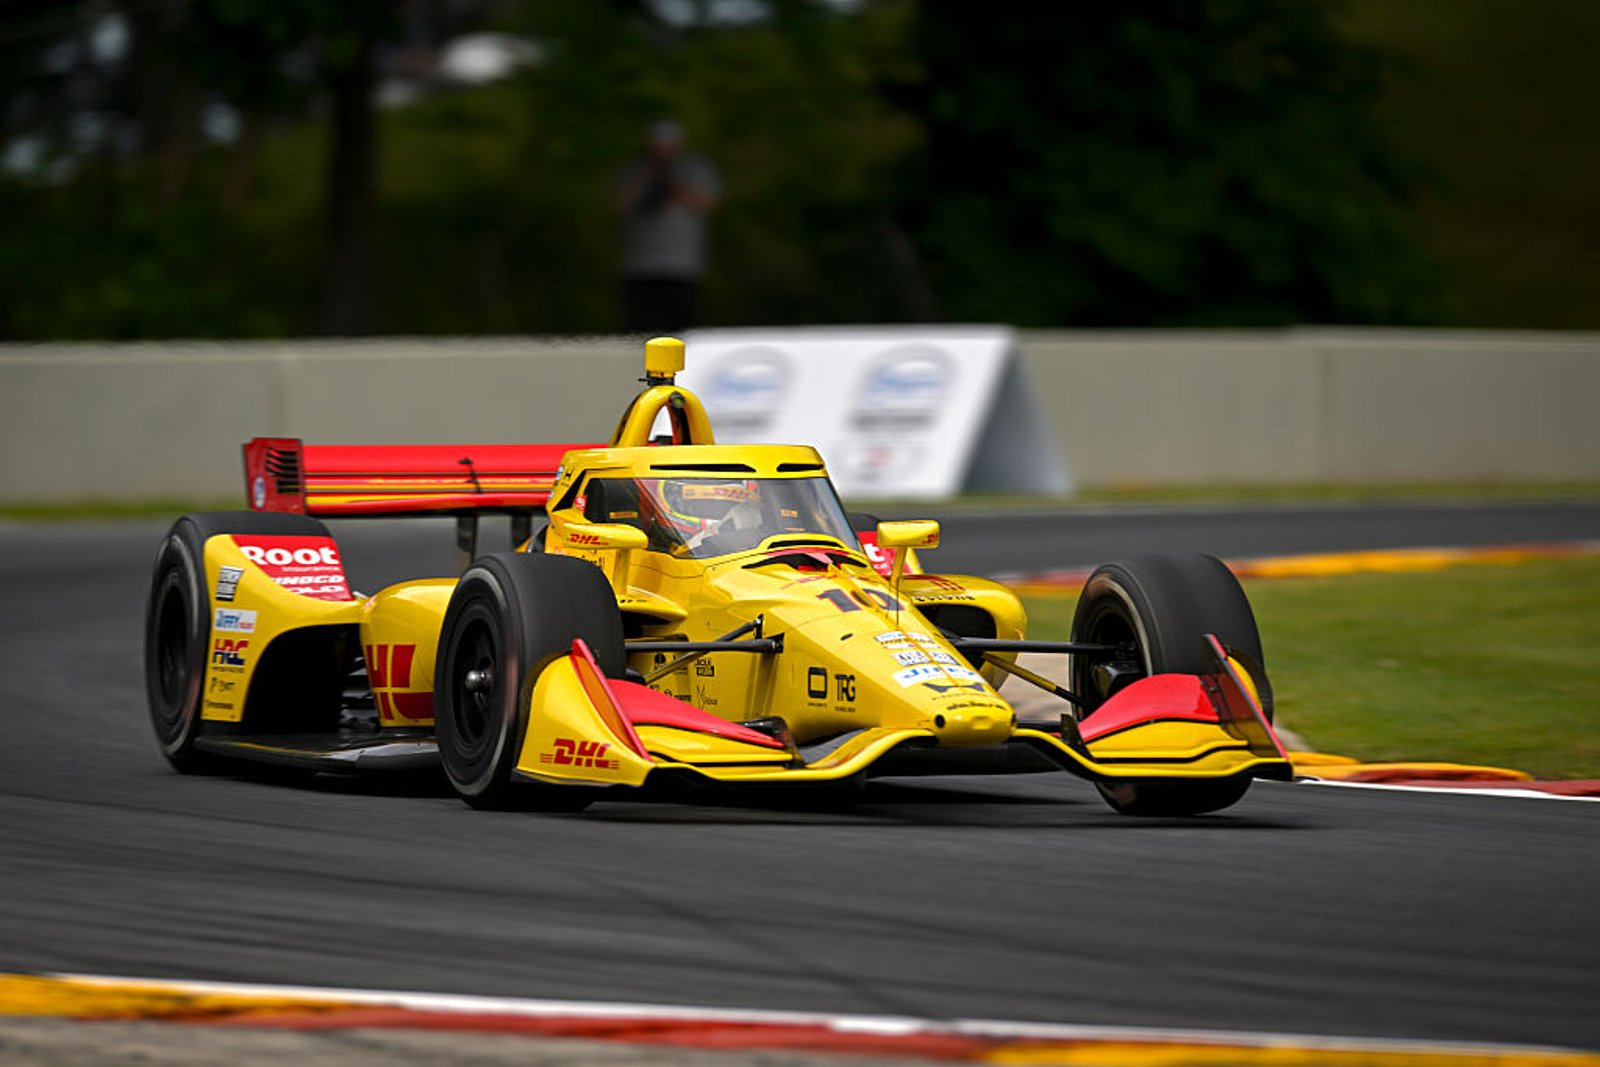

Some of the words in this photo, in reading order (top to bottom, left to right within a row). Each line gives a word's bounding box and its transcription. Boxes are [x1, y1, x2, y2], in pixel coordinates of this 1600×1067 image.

[569, 533, 603, 545] DHL
[240, 546, 340, 565] Root
[816, 588, 905, 613] 10
[366, 644, 434, 720] HL
[552, 738, 611, 769] DHL
